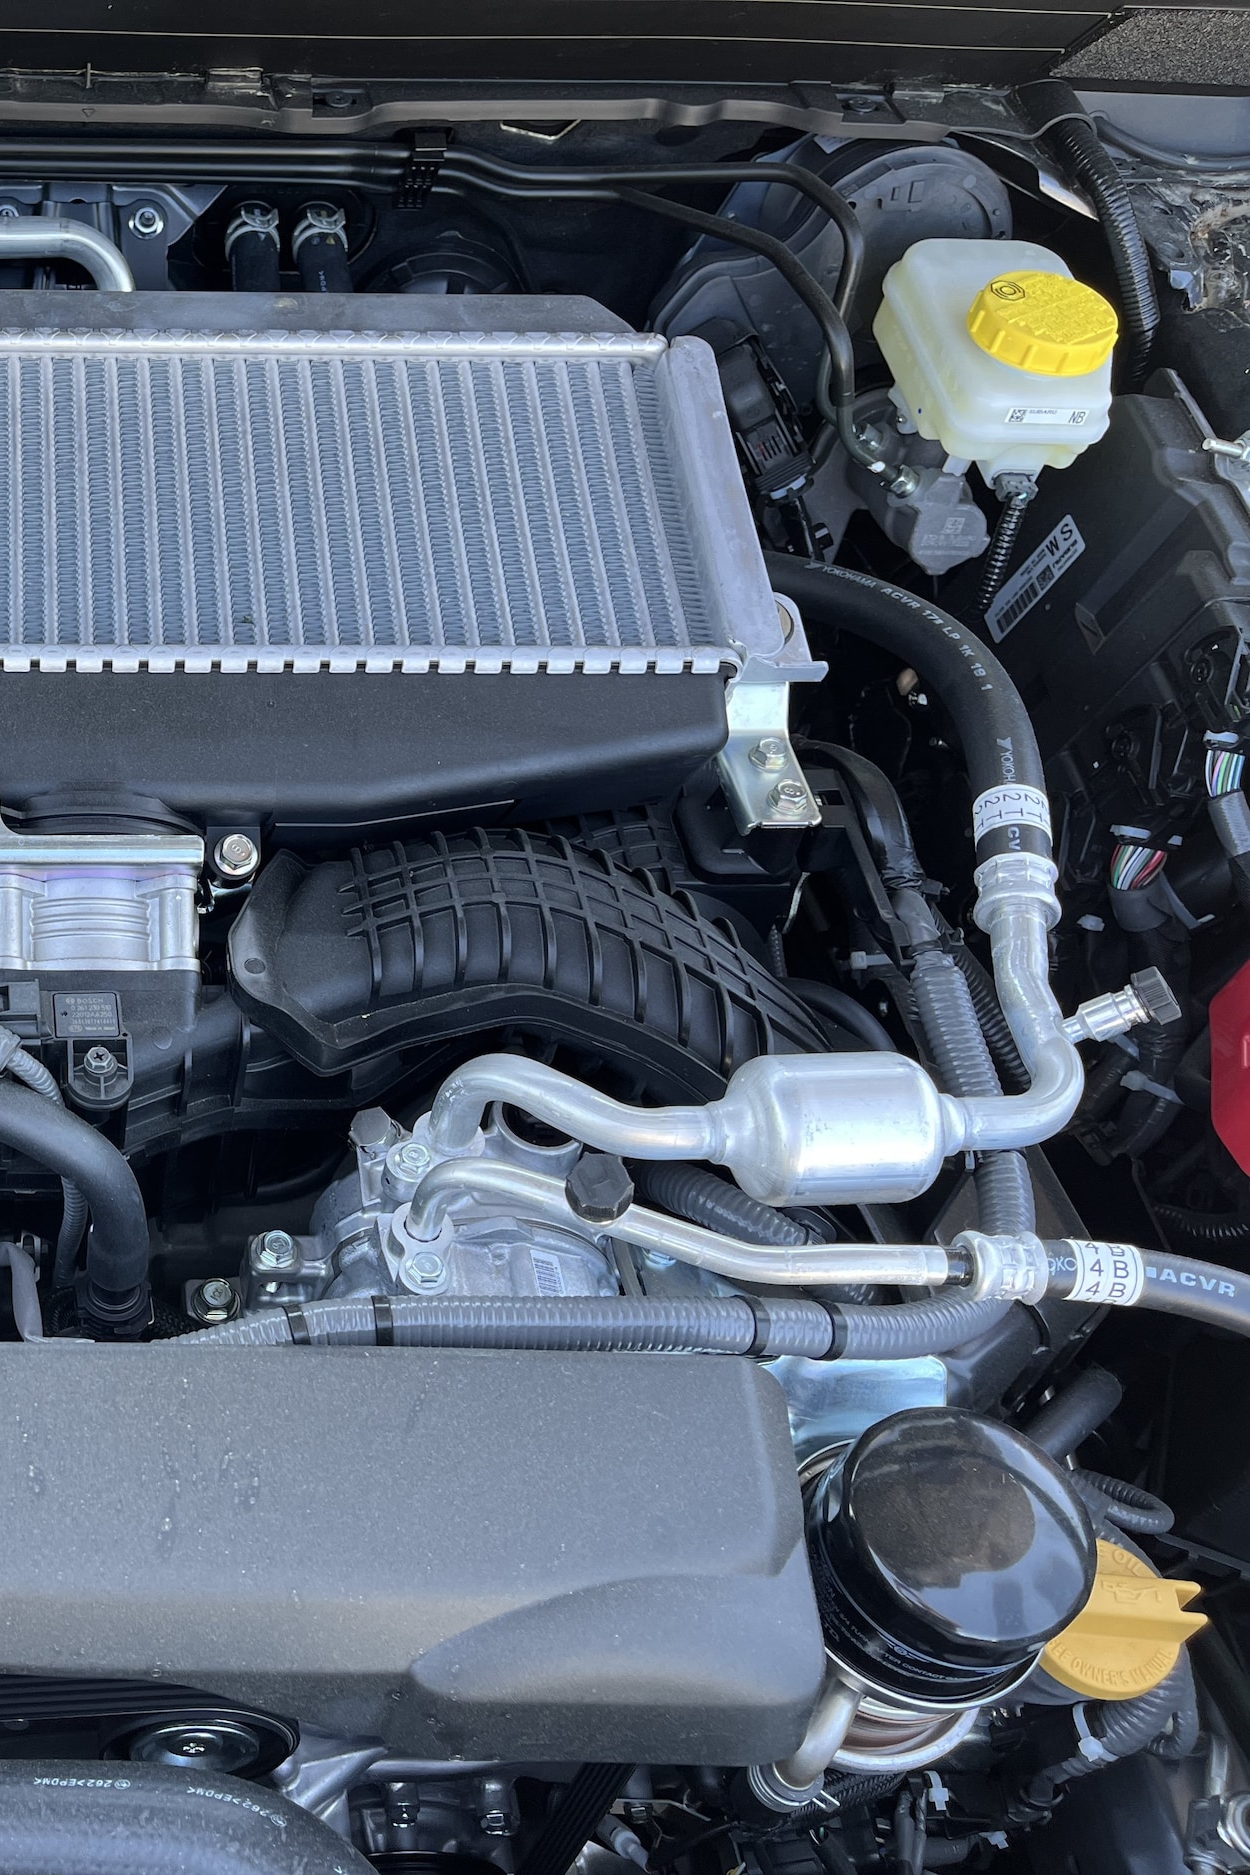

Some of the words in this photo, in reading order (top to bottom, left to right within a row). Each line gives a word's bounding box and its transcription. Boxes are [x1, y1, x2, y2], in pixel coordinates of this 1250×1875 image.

[1067, 410, 1087, 425] NB
[822, 565, 877, 589] YOKOHAMA
[880, 586, 921, 610] ACVR
[942, 626, 961, 641] LP
[1000, 750, 1016, 784] YOKOH
[1158, 1267, 1236, 1298] ACVR
[1111, 1549, 1142, 1577] OIL
[1070, 1657, 1130, 1688] OWNER'S
[1129, 1647, 1174, 1685] MANUAL
